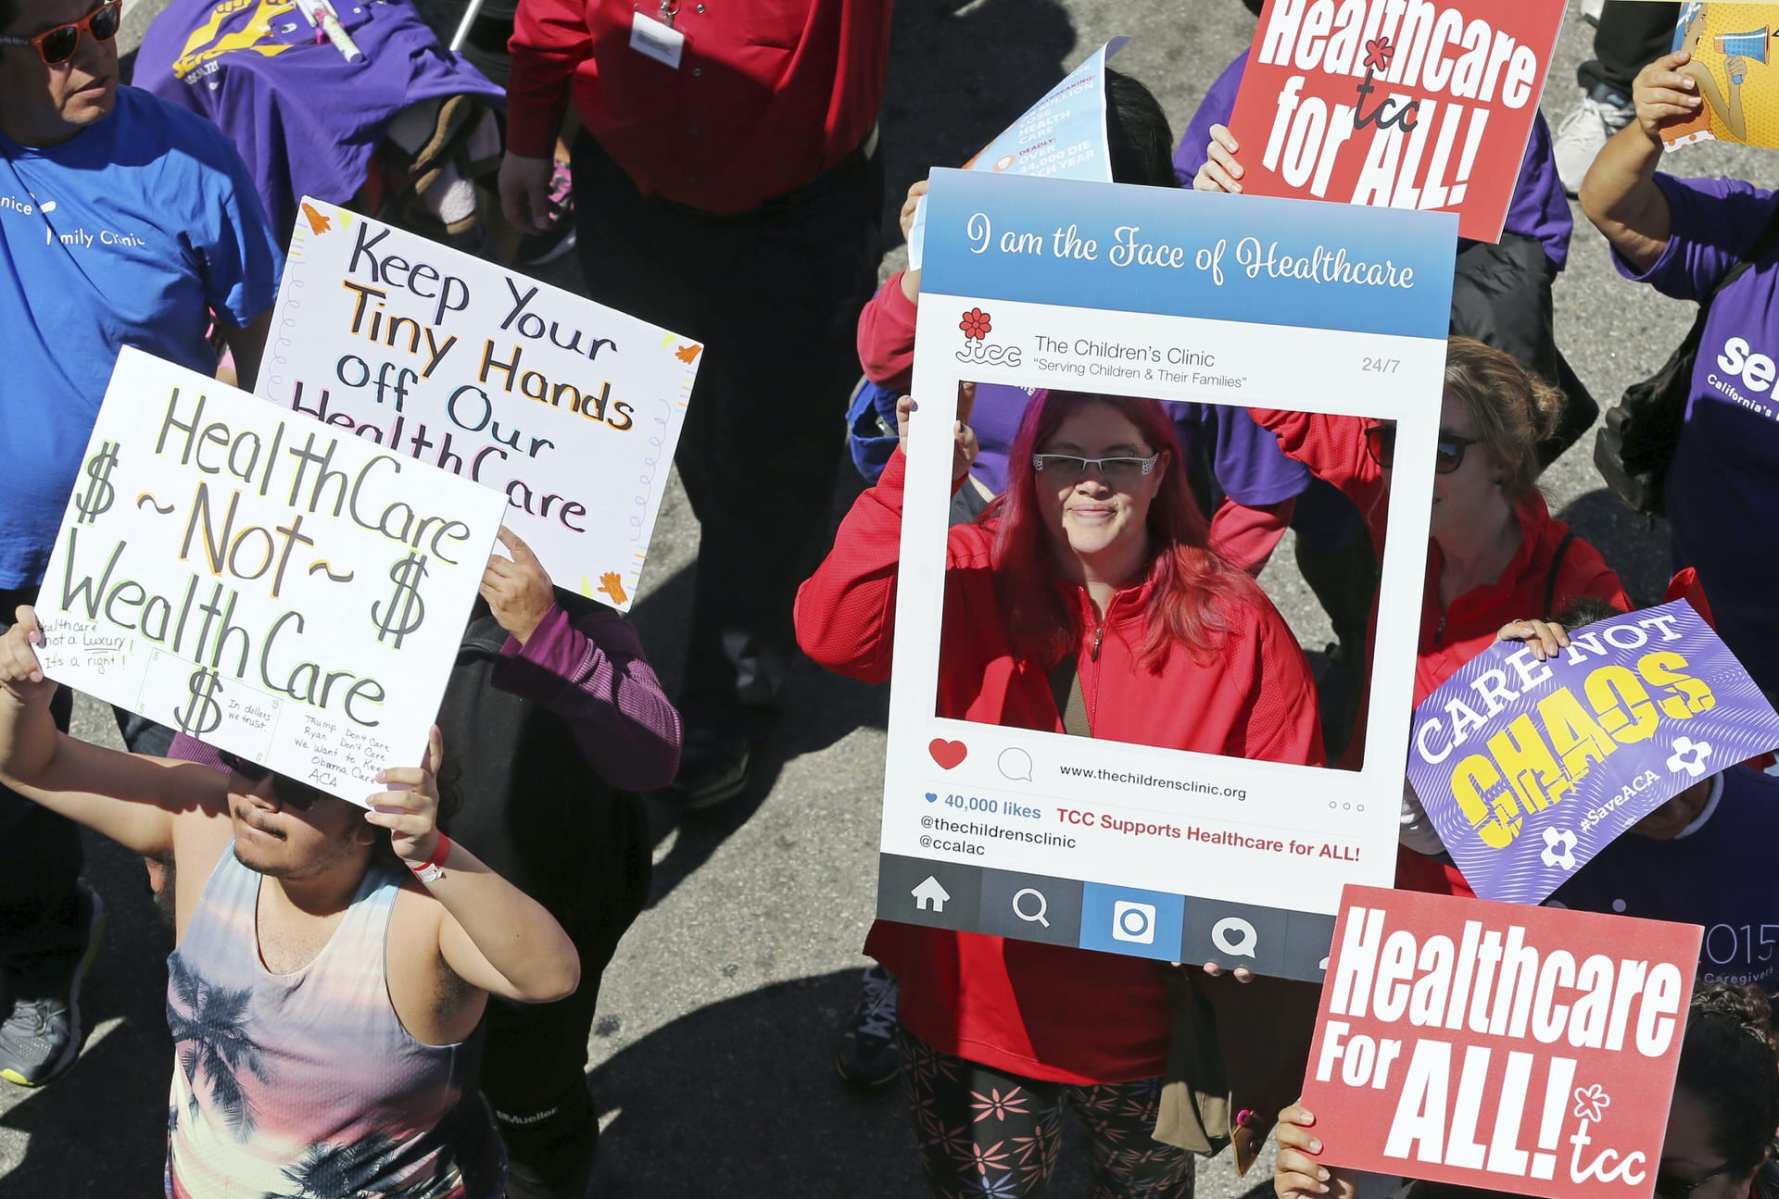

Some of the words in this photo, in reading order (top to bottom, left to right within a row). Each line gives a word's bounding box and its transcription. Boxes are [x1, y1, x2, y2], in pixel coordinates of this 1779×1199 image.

[1258, 0, 1537, 109] Healthcare
[1262, 76, 1356, 198] for
[1350, 93, 1490, 210] ALL!
[966, 212, 991, 254] I
[1000, 230, 1042, 255] am
[1052, 224, 1097, 261] the
[1108, 225, 1185, 268] Face
[1195, 239, 1227, 286] of
[1235, 236, 1415, 289] Healthcare
[349, 221, 469, 325] Keep
[500, 277, 617, 361] Your
[343, 280, 457, 379] Tiny
[479, 339, 635, 432] Hands
[1035, 335, 1069, 354] The
[1074, 338, 1161, 364] Children's
[1167, 347, 1215, 368] Clinic
[1089, 363, 1140, 379] Children
[1144, 369, 1153, 380] &
[1159, 369, 1188, 384] Their
[1362, 355, 1401, 375] 24/7
[446, 385, 555, 459] Our
[1707, 374, 1772, 418] California's
[155, 387, 471, 565] HealthCare
[179, 481, 314, 598] Not
[1417, 646, 1553, 765] CARE
[1565, 614, 1683, 667] NOT
[308, 768, 338, 788] ACA
[1060, 765, 1247, 801] www.thechildrensclinic.org
[1451, 651, 1716, 850] CHAOS
[920, 815, 1077, 849] @thechildrensclinic
[944, 794, 998, 814] 40,000
[1003, 801, 1041, 820] likes
[1056, 808, 1096, 827] TCC
[1100, 814, 1181, 840] Supports
[1187, 826, 1283, 852] Healthcare
[1289, 839, 1315, 856] for
[1319, 843, 1360, 862] ALL!
[1581, 769, 1660, 833] #SaveACA
[919, 834, 986, 856] @ccalac
[1329, 906, 1682, 1058] Healthcare
[1315, 1020, 1402, 1090] For
[1383, 1038, 1577, 1181] ALL!
[1568, 1118, 1647, 1185] tcc
